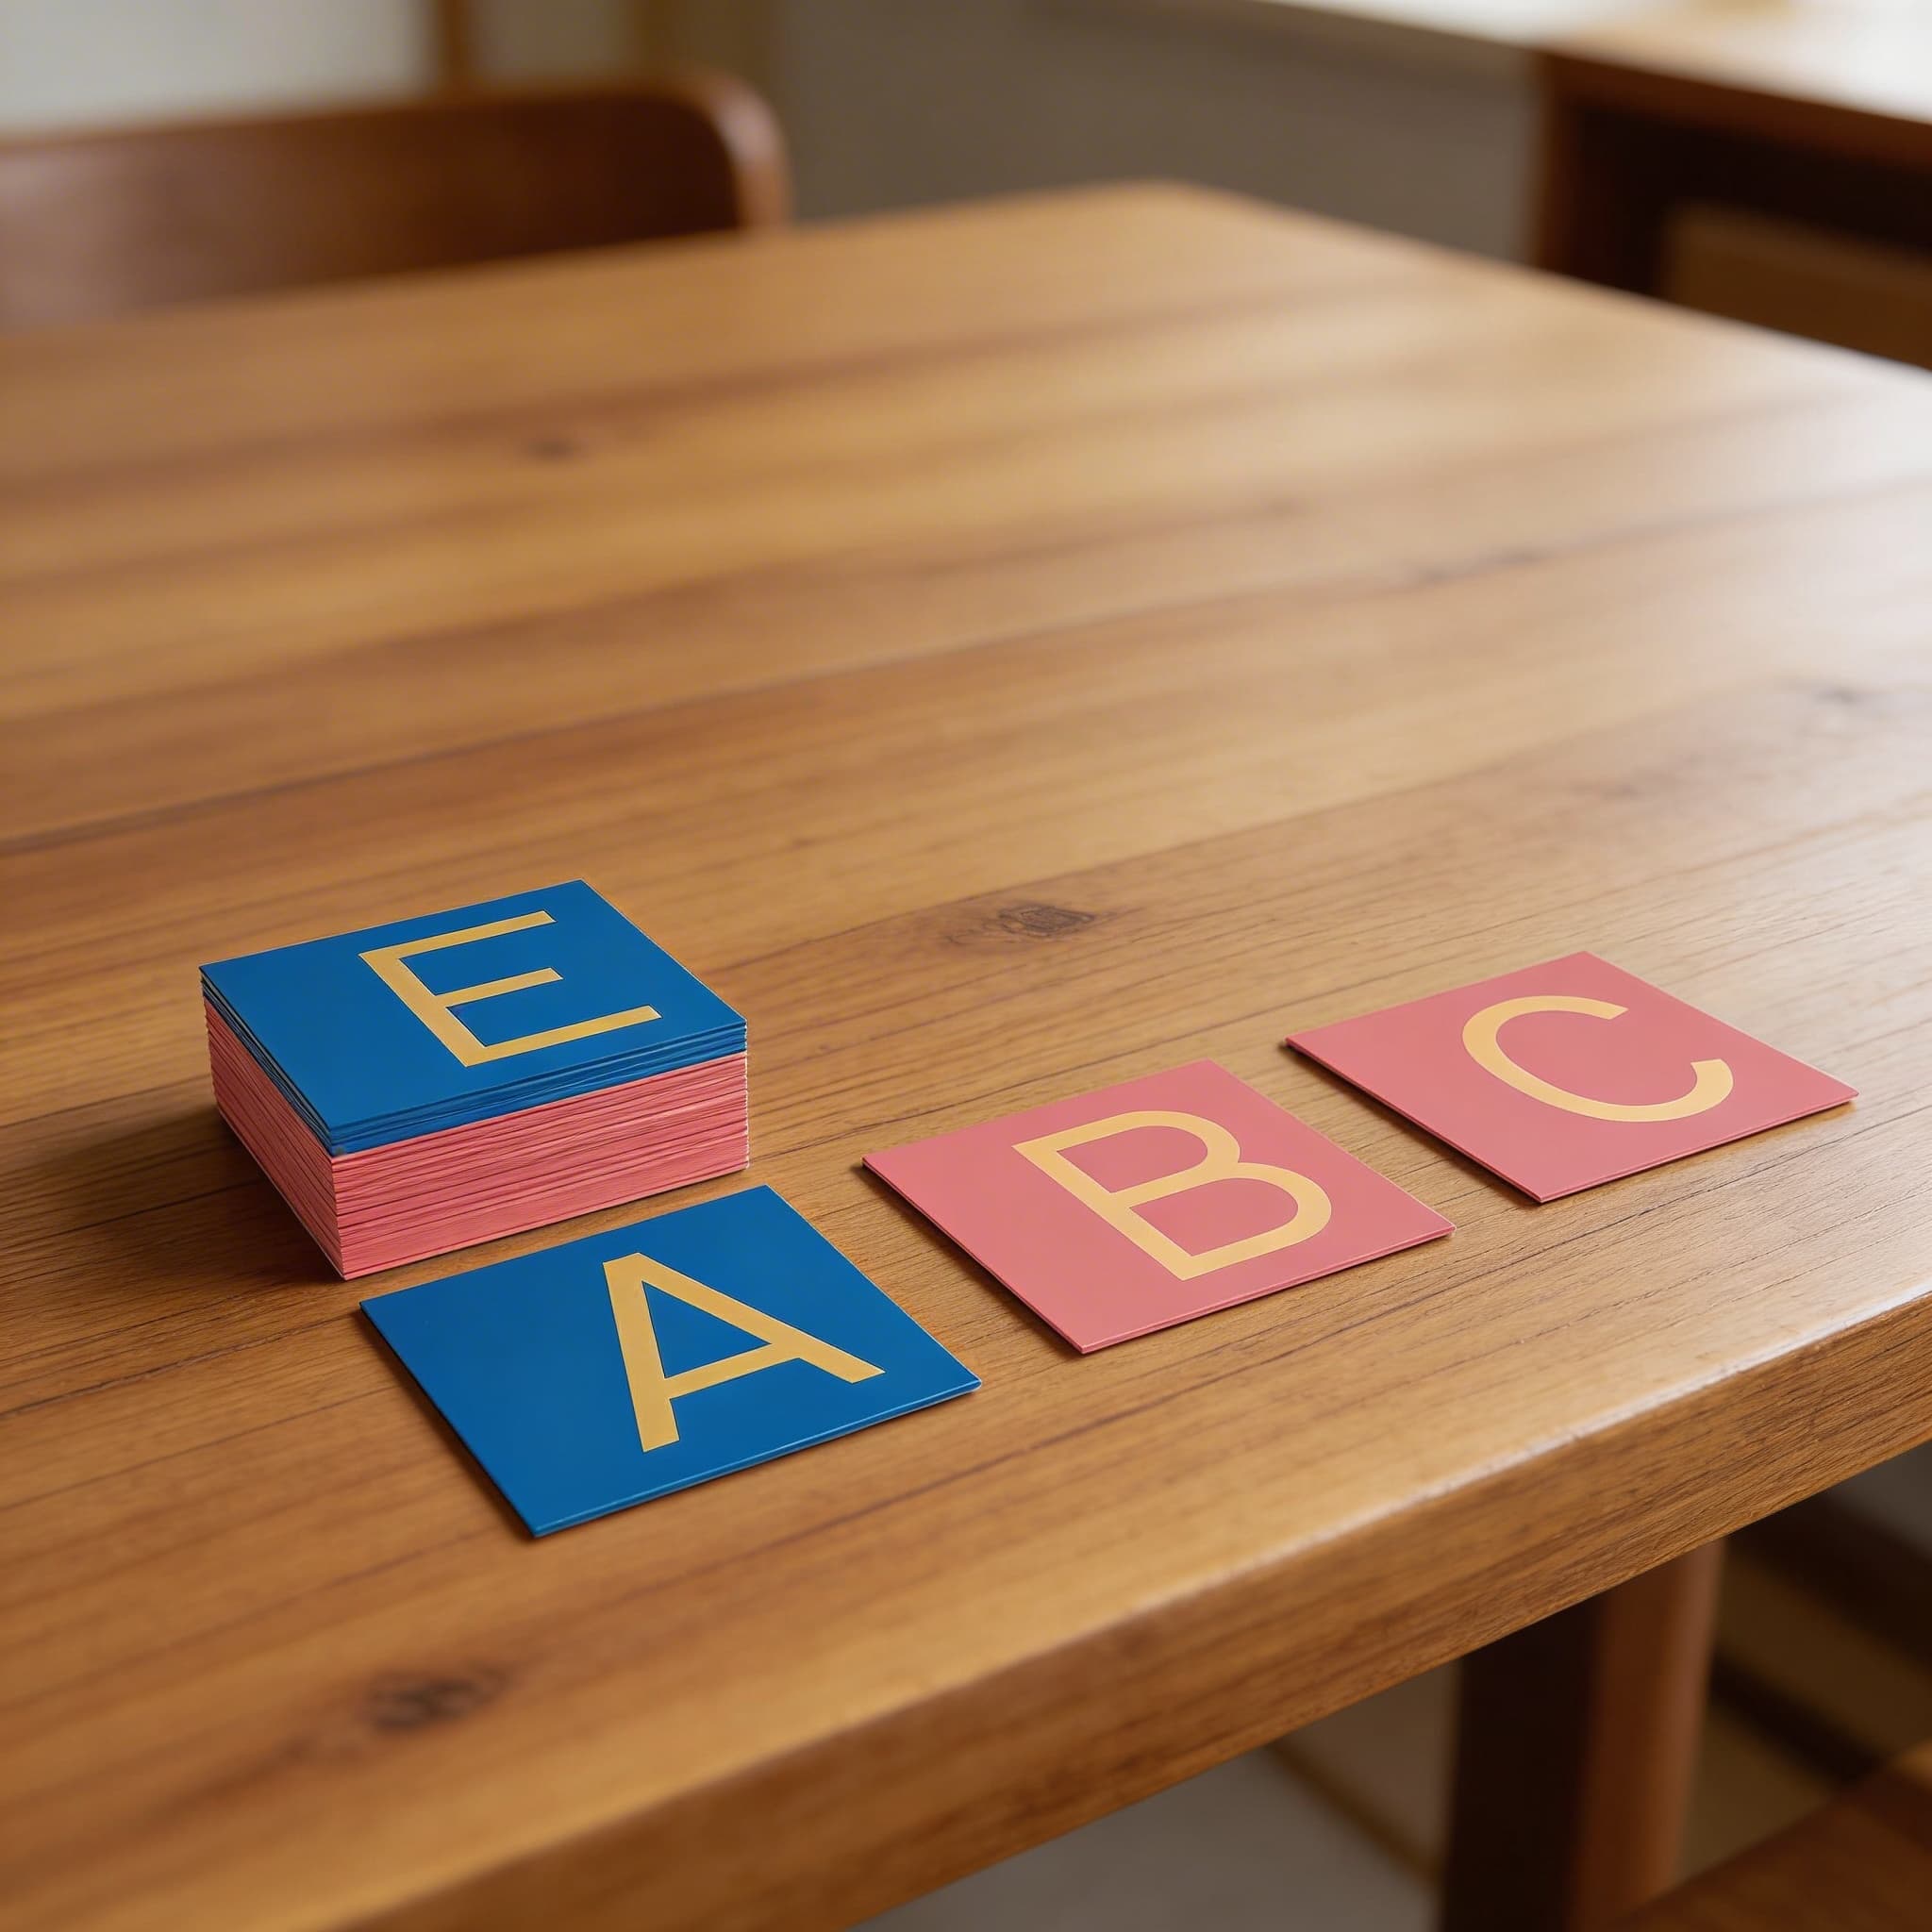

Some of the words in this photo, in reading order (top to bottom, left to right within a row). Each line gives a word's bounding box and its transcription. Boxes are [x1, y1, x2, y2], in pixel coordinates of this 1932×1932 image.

[358, 910, 661, 1067] E
[1462, 995, 1734, 1122] C
[1014, 1110, 1332, 1280] B
[603, 1252, 885, 1452] A
